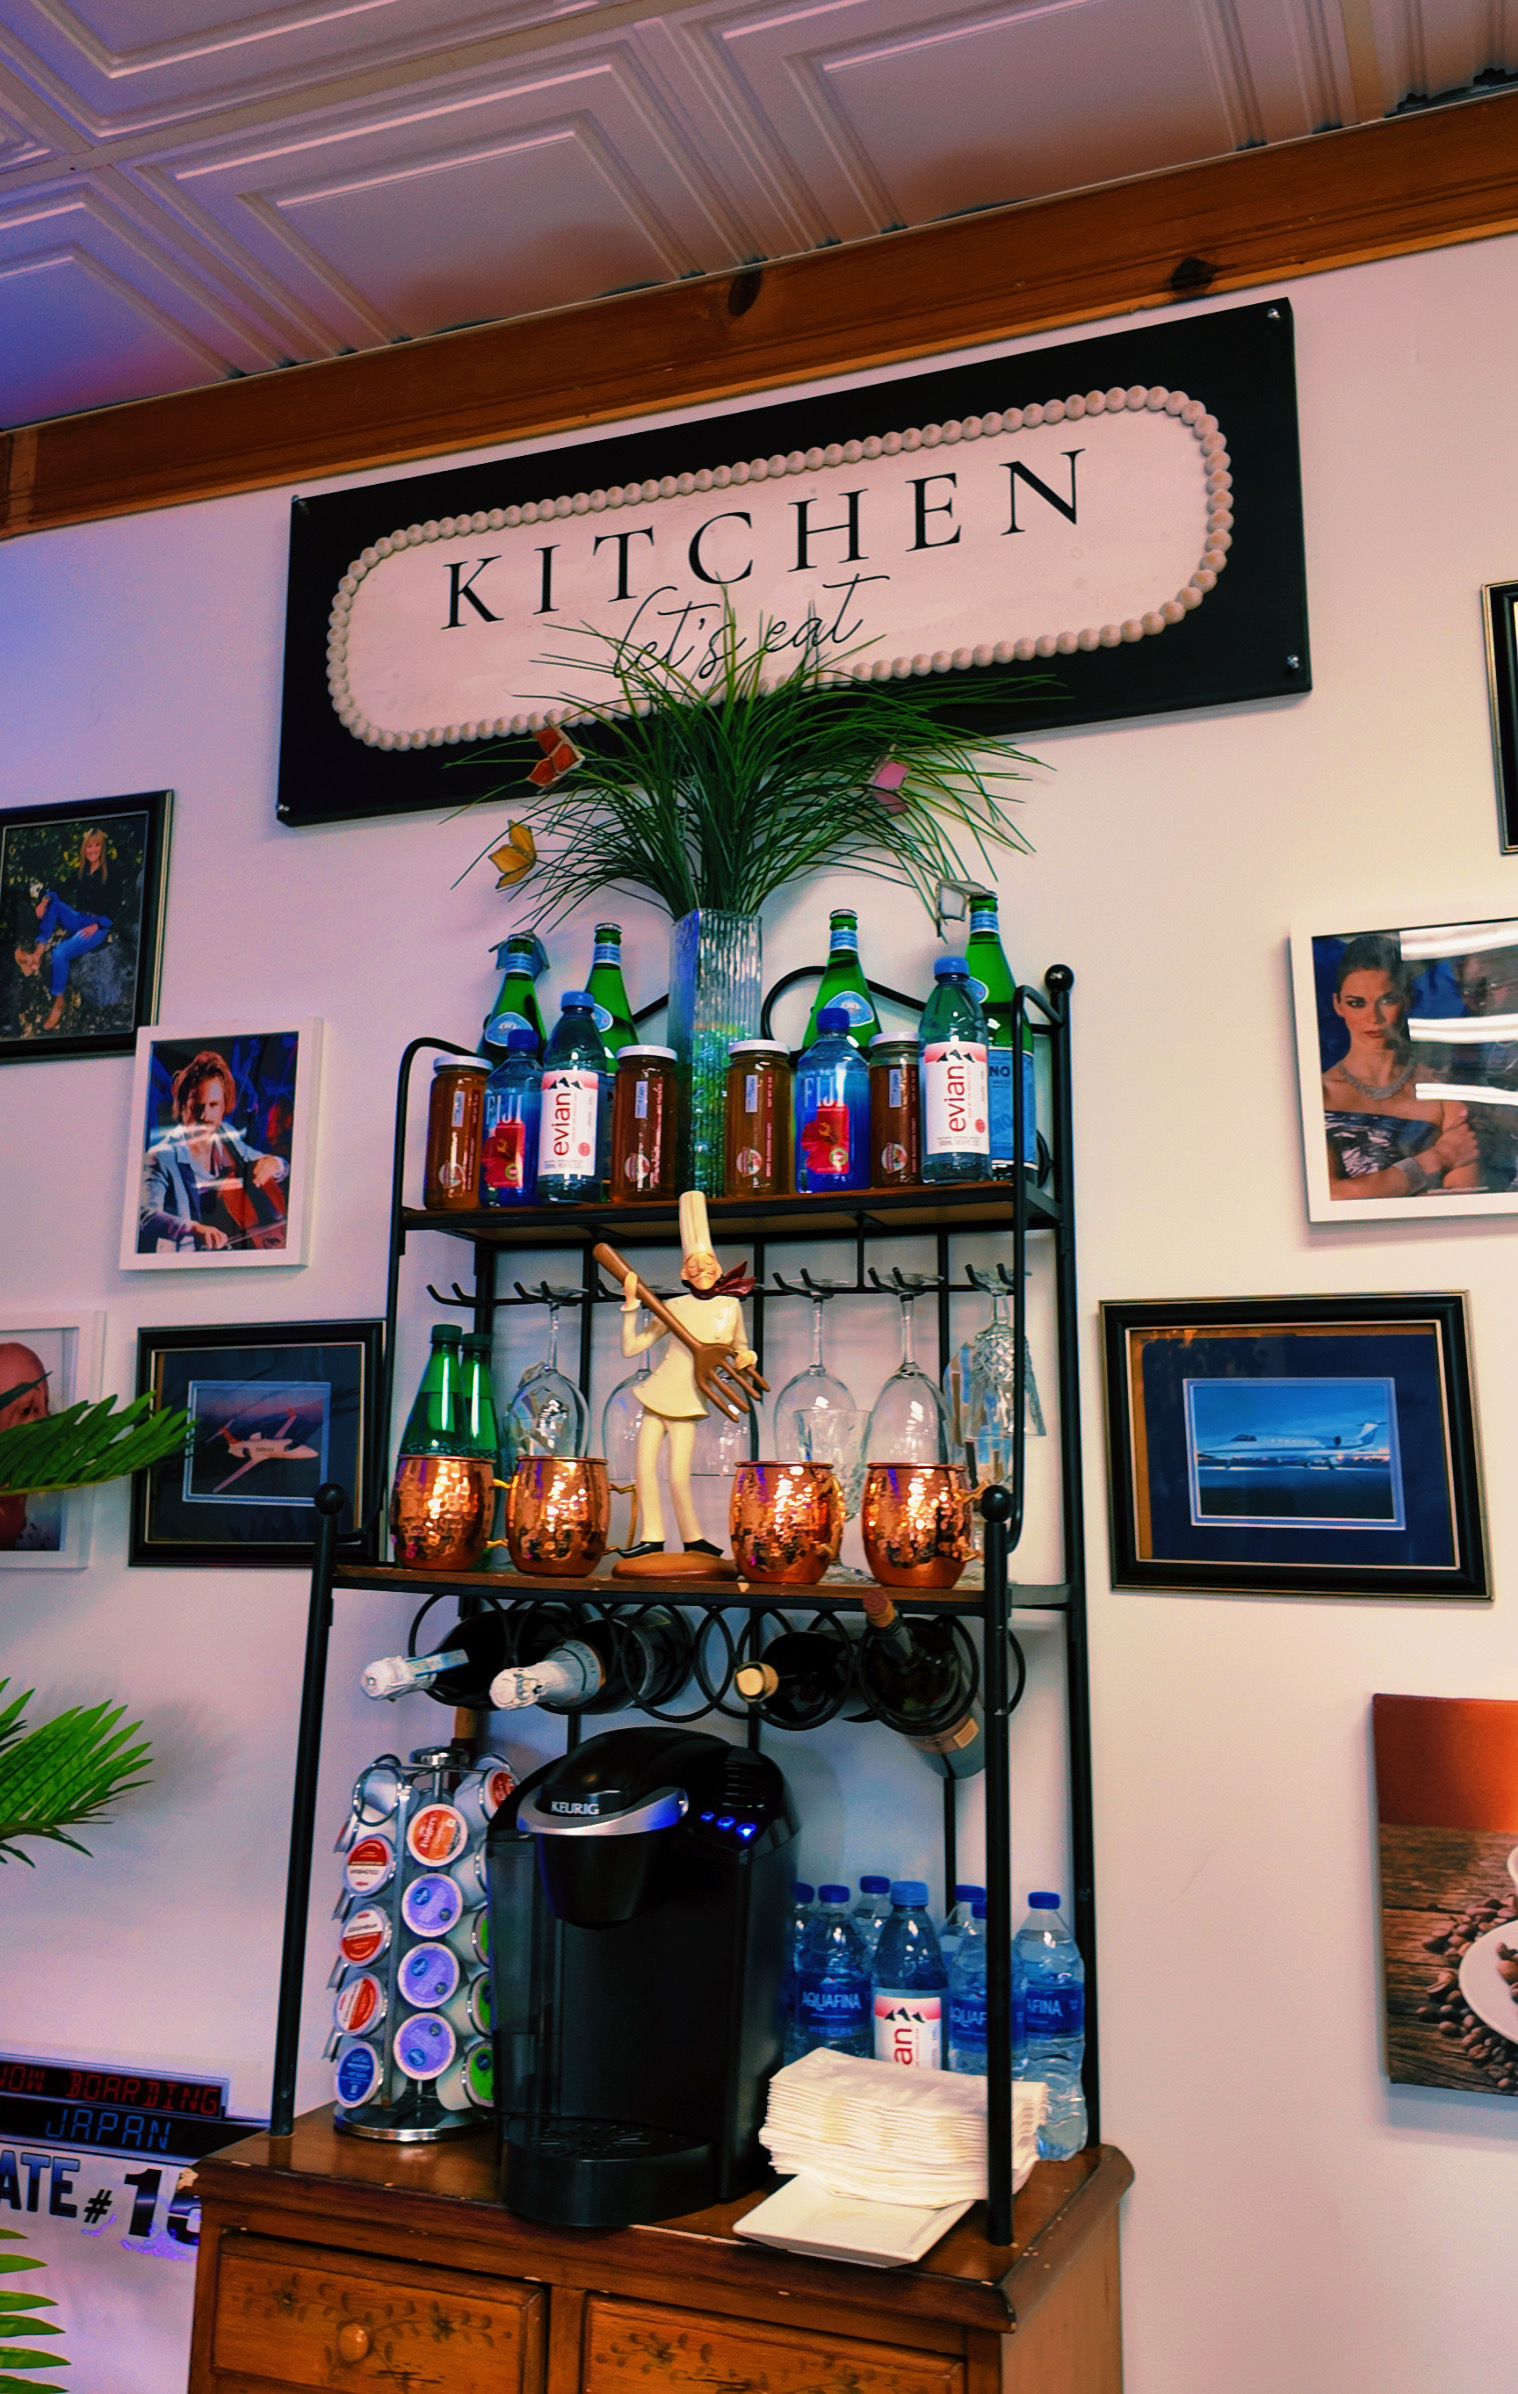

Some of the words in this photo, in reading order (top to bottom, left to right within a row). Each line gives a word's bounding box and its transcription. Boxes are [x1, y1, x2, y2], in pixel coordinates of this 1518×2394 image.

[441, 448, 1086, 630] KITCHEN
[764, 573, 890, 653] eat
[485, 1094, 524, 1125] FIJI
[804, 1075, 845, 1108] FIJI
[943, 1065, 967, 1132] evian
[551, 1092, 572, 1157] evian
[551, 1801, 600, 1815] KEURIG
[801, 1991, 862, 2011] AQUAFINA
[66, 2070, 220, 2116] BOARDING
[46, 2108, 171, 2150] JAPAN
[0, 2150, 80, 2218] ATE
